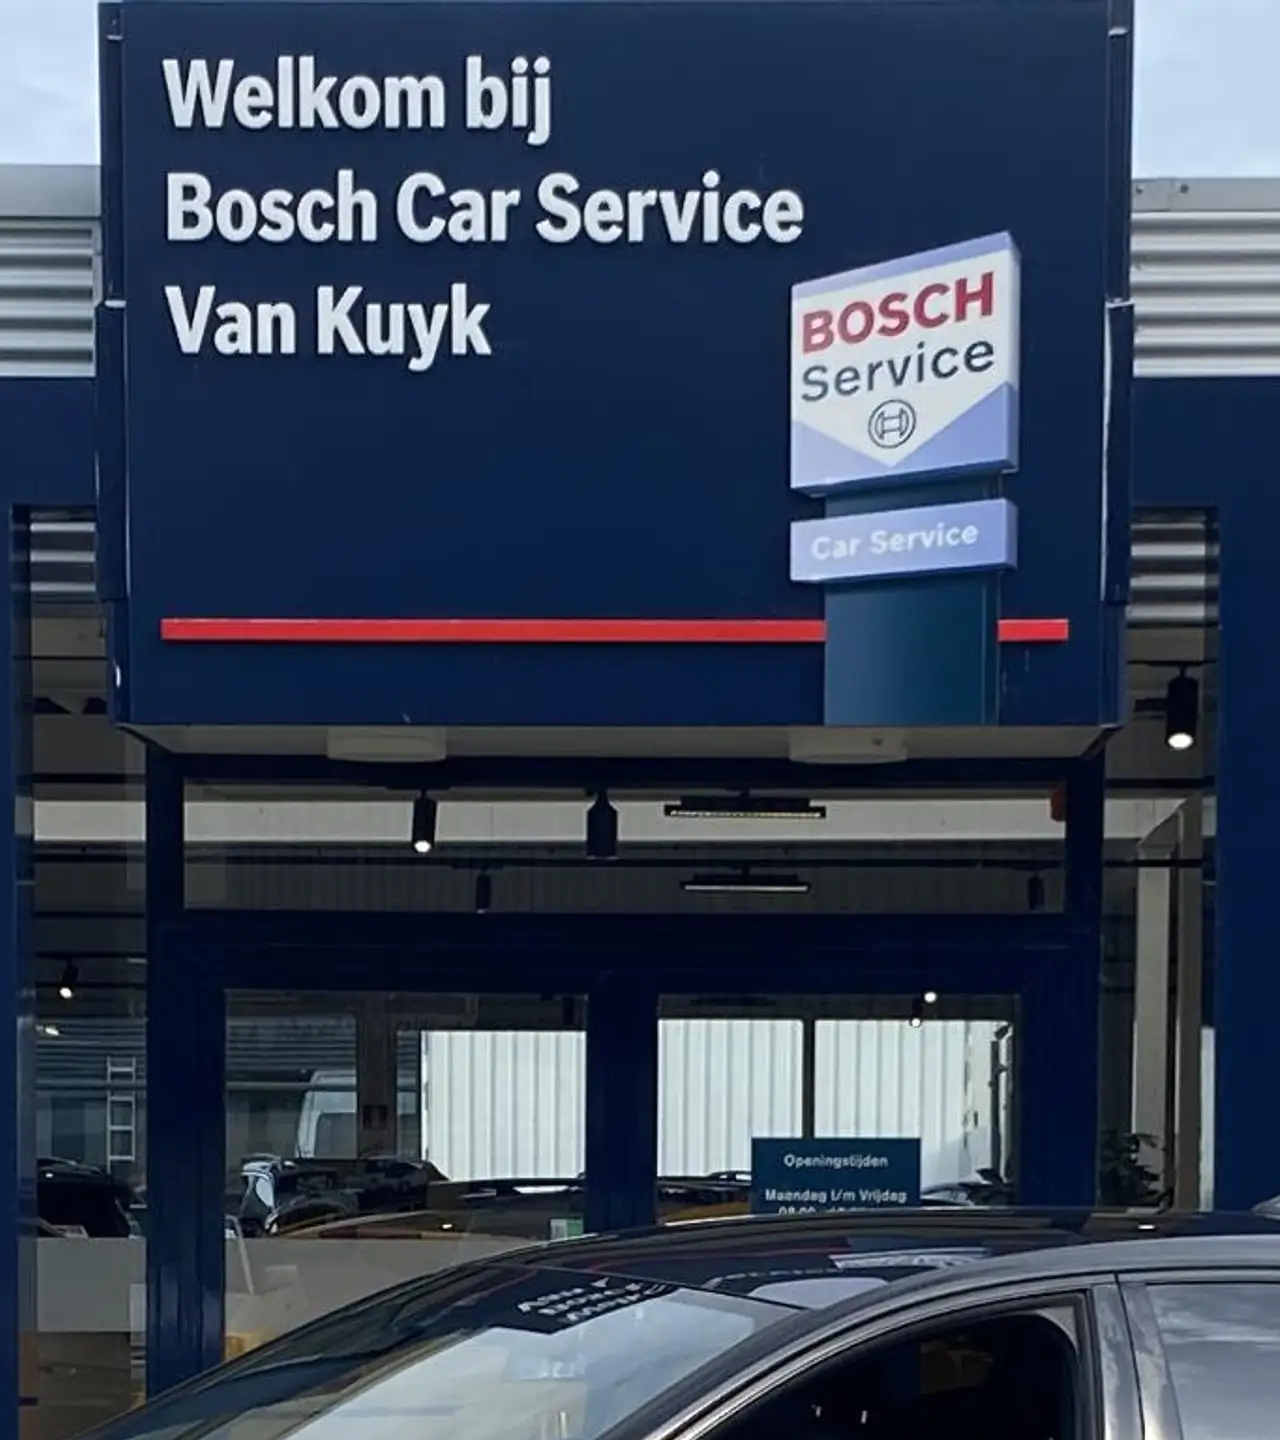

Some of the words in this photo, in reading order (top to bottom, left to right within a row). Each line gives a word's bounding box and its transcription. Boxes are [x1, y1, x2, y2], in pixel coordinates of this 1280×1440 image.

[163, 56, 446, 129] Welkom
[466, 56, 551, 145] bij
[167, 169, 377, 242] Bosch
[397, 172, 520, 242] Car
[536, 170, 804, 243] Service
[165, 285, 296, 354] Van
[317, 283, 492, 371] Kuyk
[802, 271, 994, 354] BOSCH
[801, 339, 995, 403] Service
[811, 536, 861, 560] Car
[869, 523, 980, 555] Service
[765, 1188, 827, 1203] Maandag
[859, 1188, 908, 1203] Vrijdag
[783, 1154, 888, 1168] Openingstijden
